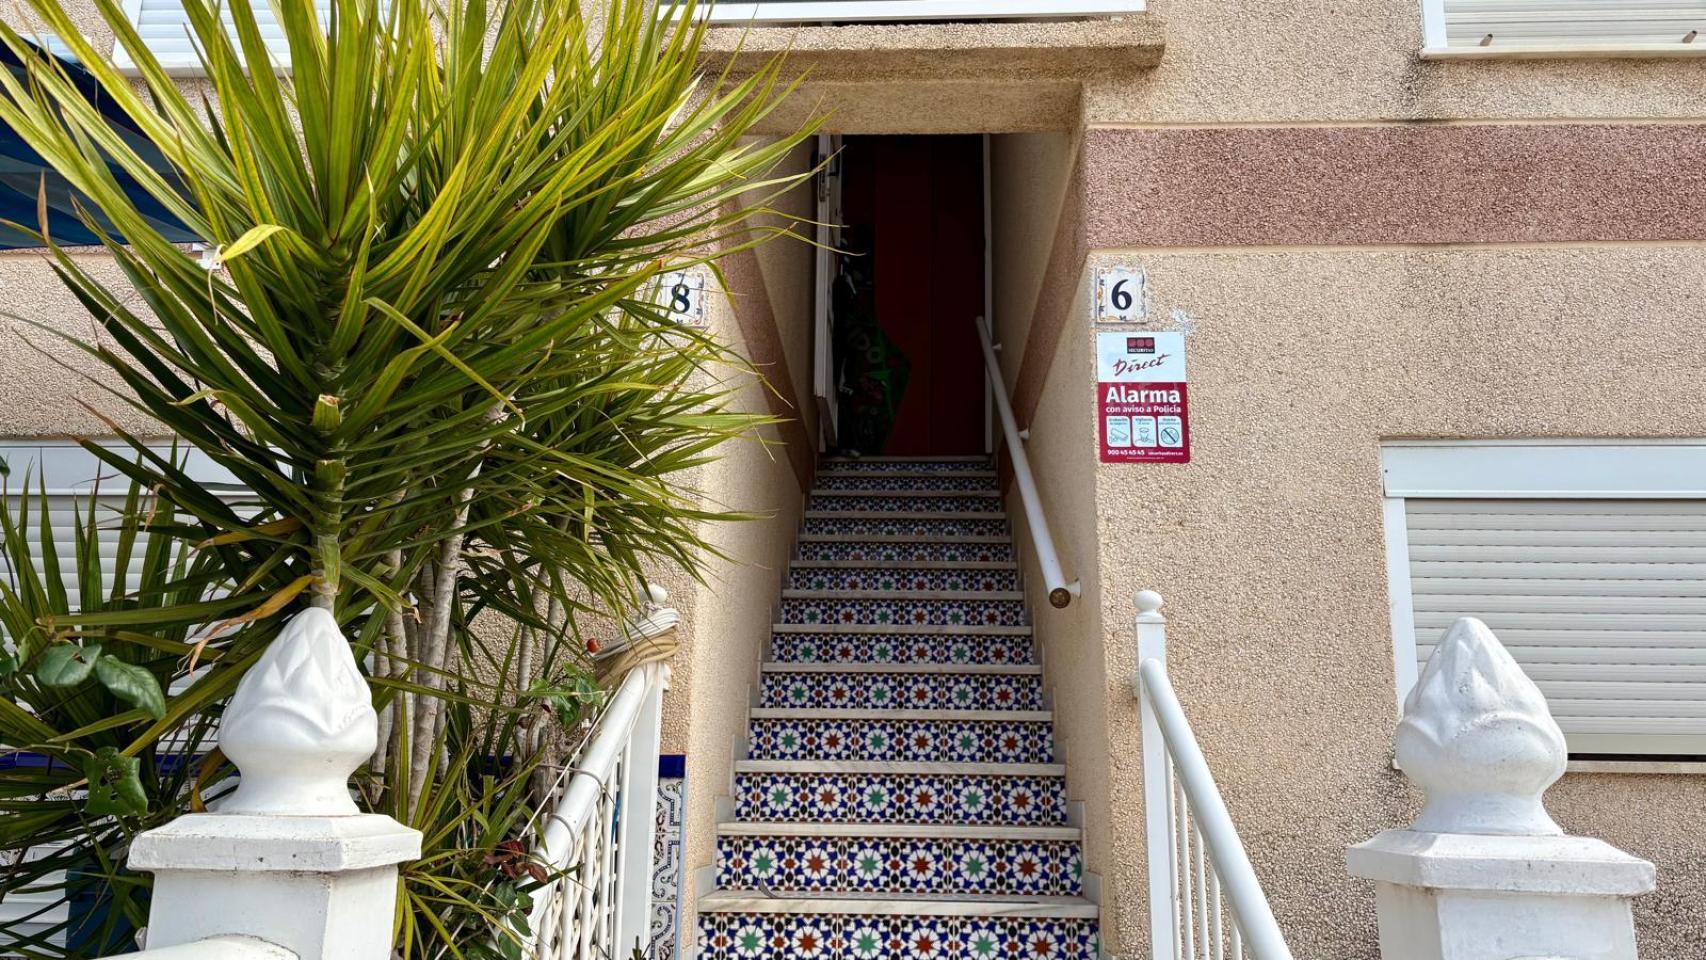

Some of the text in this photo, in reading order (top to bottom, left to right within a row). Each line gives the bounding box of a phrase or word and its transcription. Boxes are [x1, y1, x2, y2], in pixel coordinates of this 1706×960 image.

[671, 283, 691, 314] 8
[1111, 279, 1132, 311] 6
[1112, 353, 1172, 376] Direct
[1105, 386, 1181, 403] Alarma
[1122, 405, 1145, 413] aviso
[1153, 404, 1182, 413] Policía
